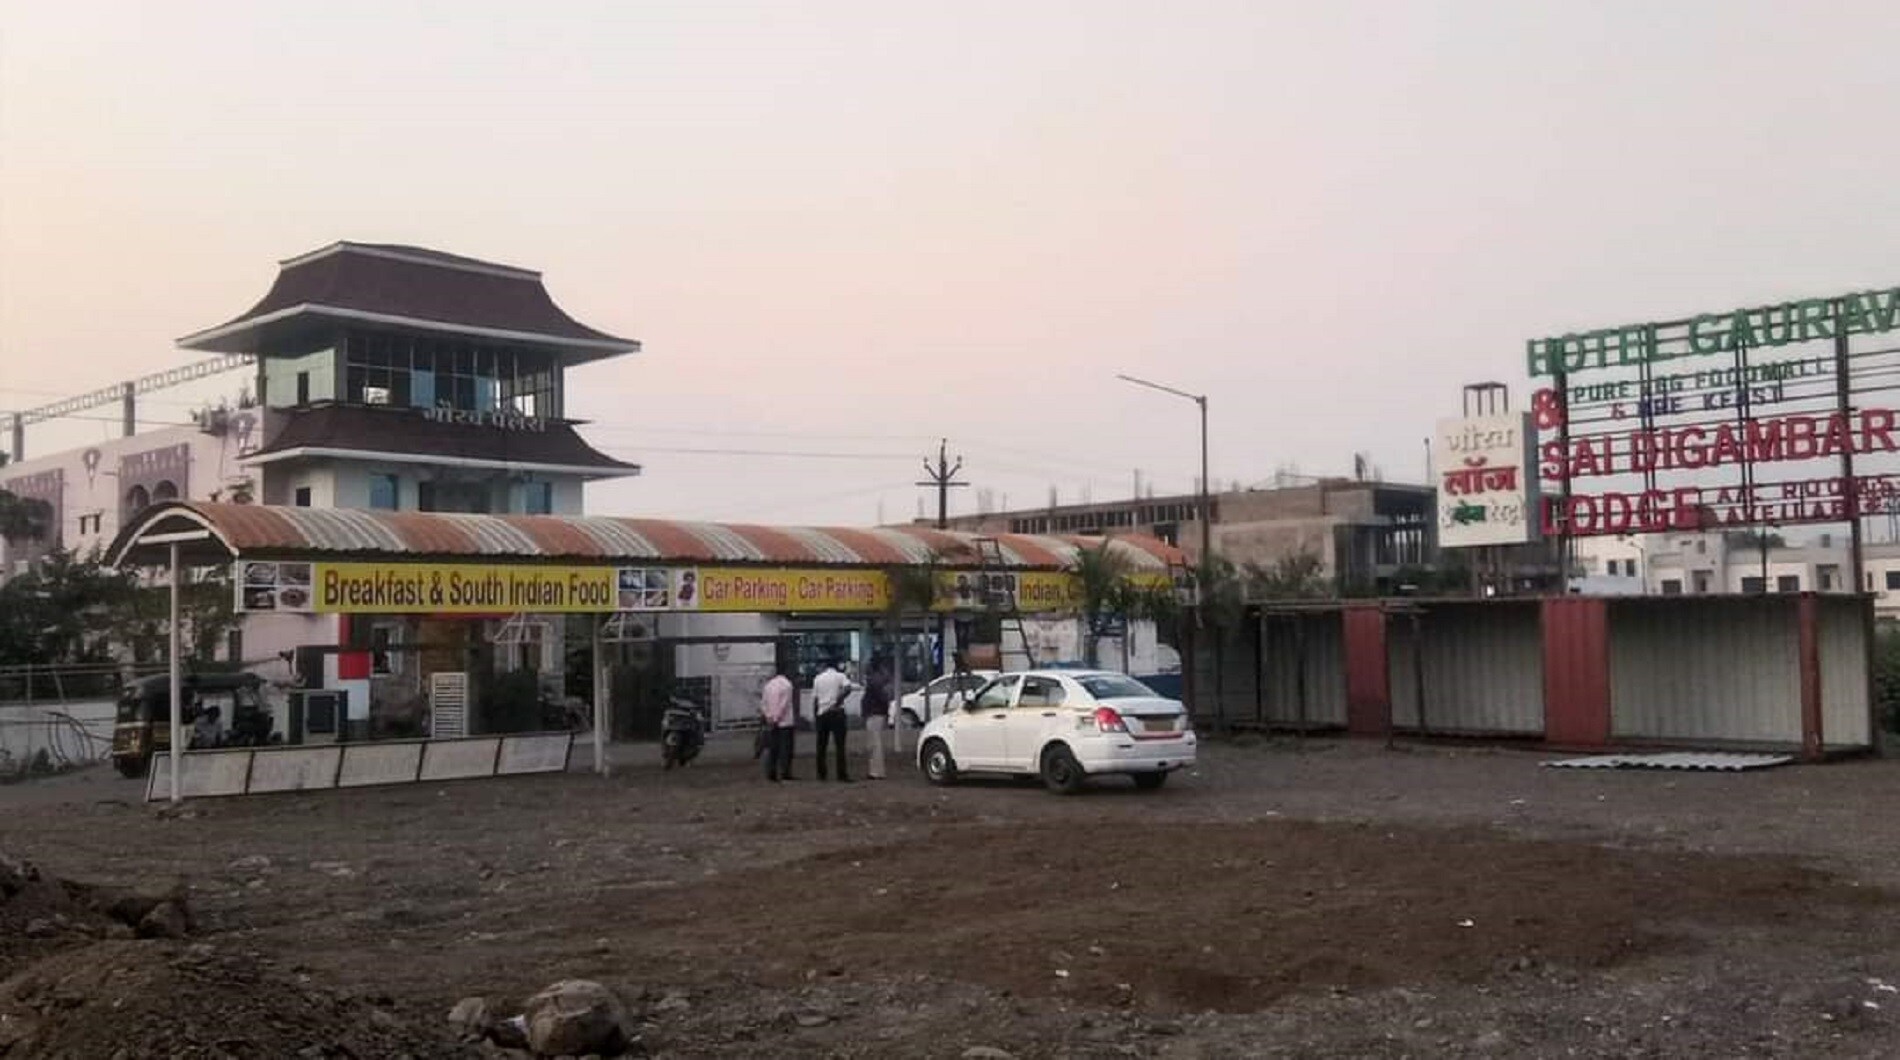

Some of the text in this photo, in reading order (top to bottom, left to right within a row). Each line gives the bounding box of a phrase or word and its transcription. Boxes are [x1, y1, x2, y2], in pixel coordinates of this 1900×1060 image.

[1527, 287, 1900, 376] HOTEL GAURAV
[1531, 387, 1561, 430] &
[1574, 381, 1630, 402] PURE
[1542, 409, 1896, 480] SAI DIGAMBAR
[1443, 456, 1517, 496] लॉज
[1541, 487, 1703, 536] LODGE
[324, 569, 610, 606] Breakfast & South Indian Food
[704, 576, 731, 600] Car
[734, 576, 787, 606] Parking
[800, 576, 823, 600] Car
[826, 576, 874, 605] Parking
